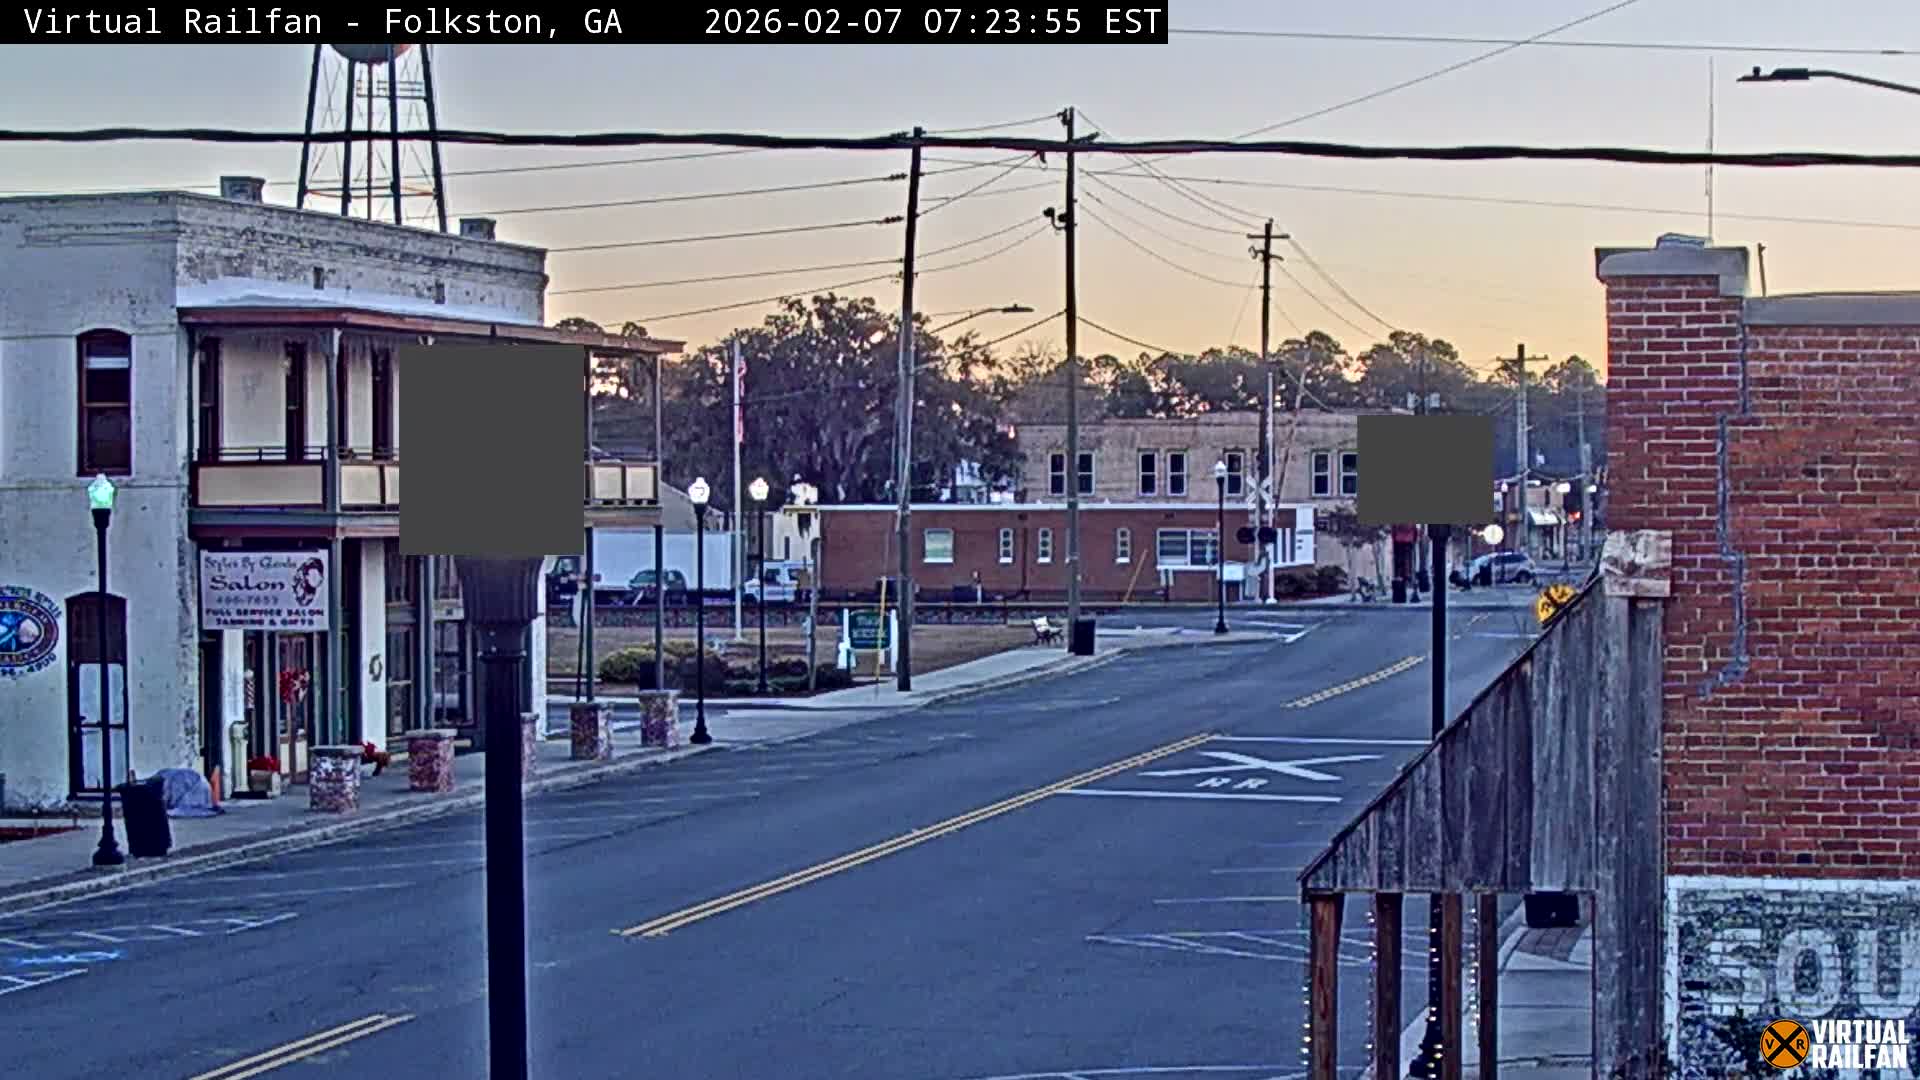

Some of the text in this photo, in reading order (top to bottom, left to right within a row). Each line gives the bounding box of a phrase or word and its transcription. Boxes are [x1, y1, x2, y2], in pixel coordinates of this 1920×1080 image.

[209, 575, 285, 591] Salon
[206, 608, 324, 616] FULL SERVICE SALON
